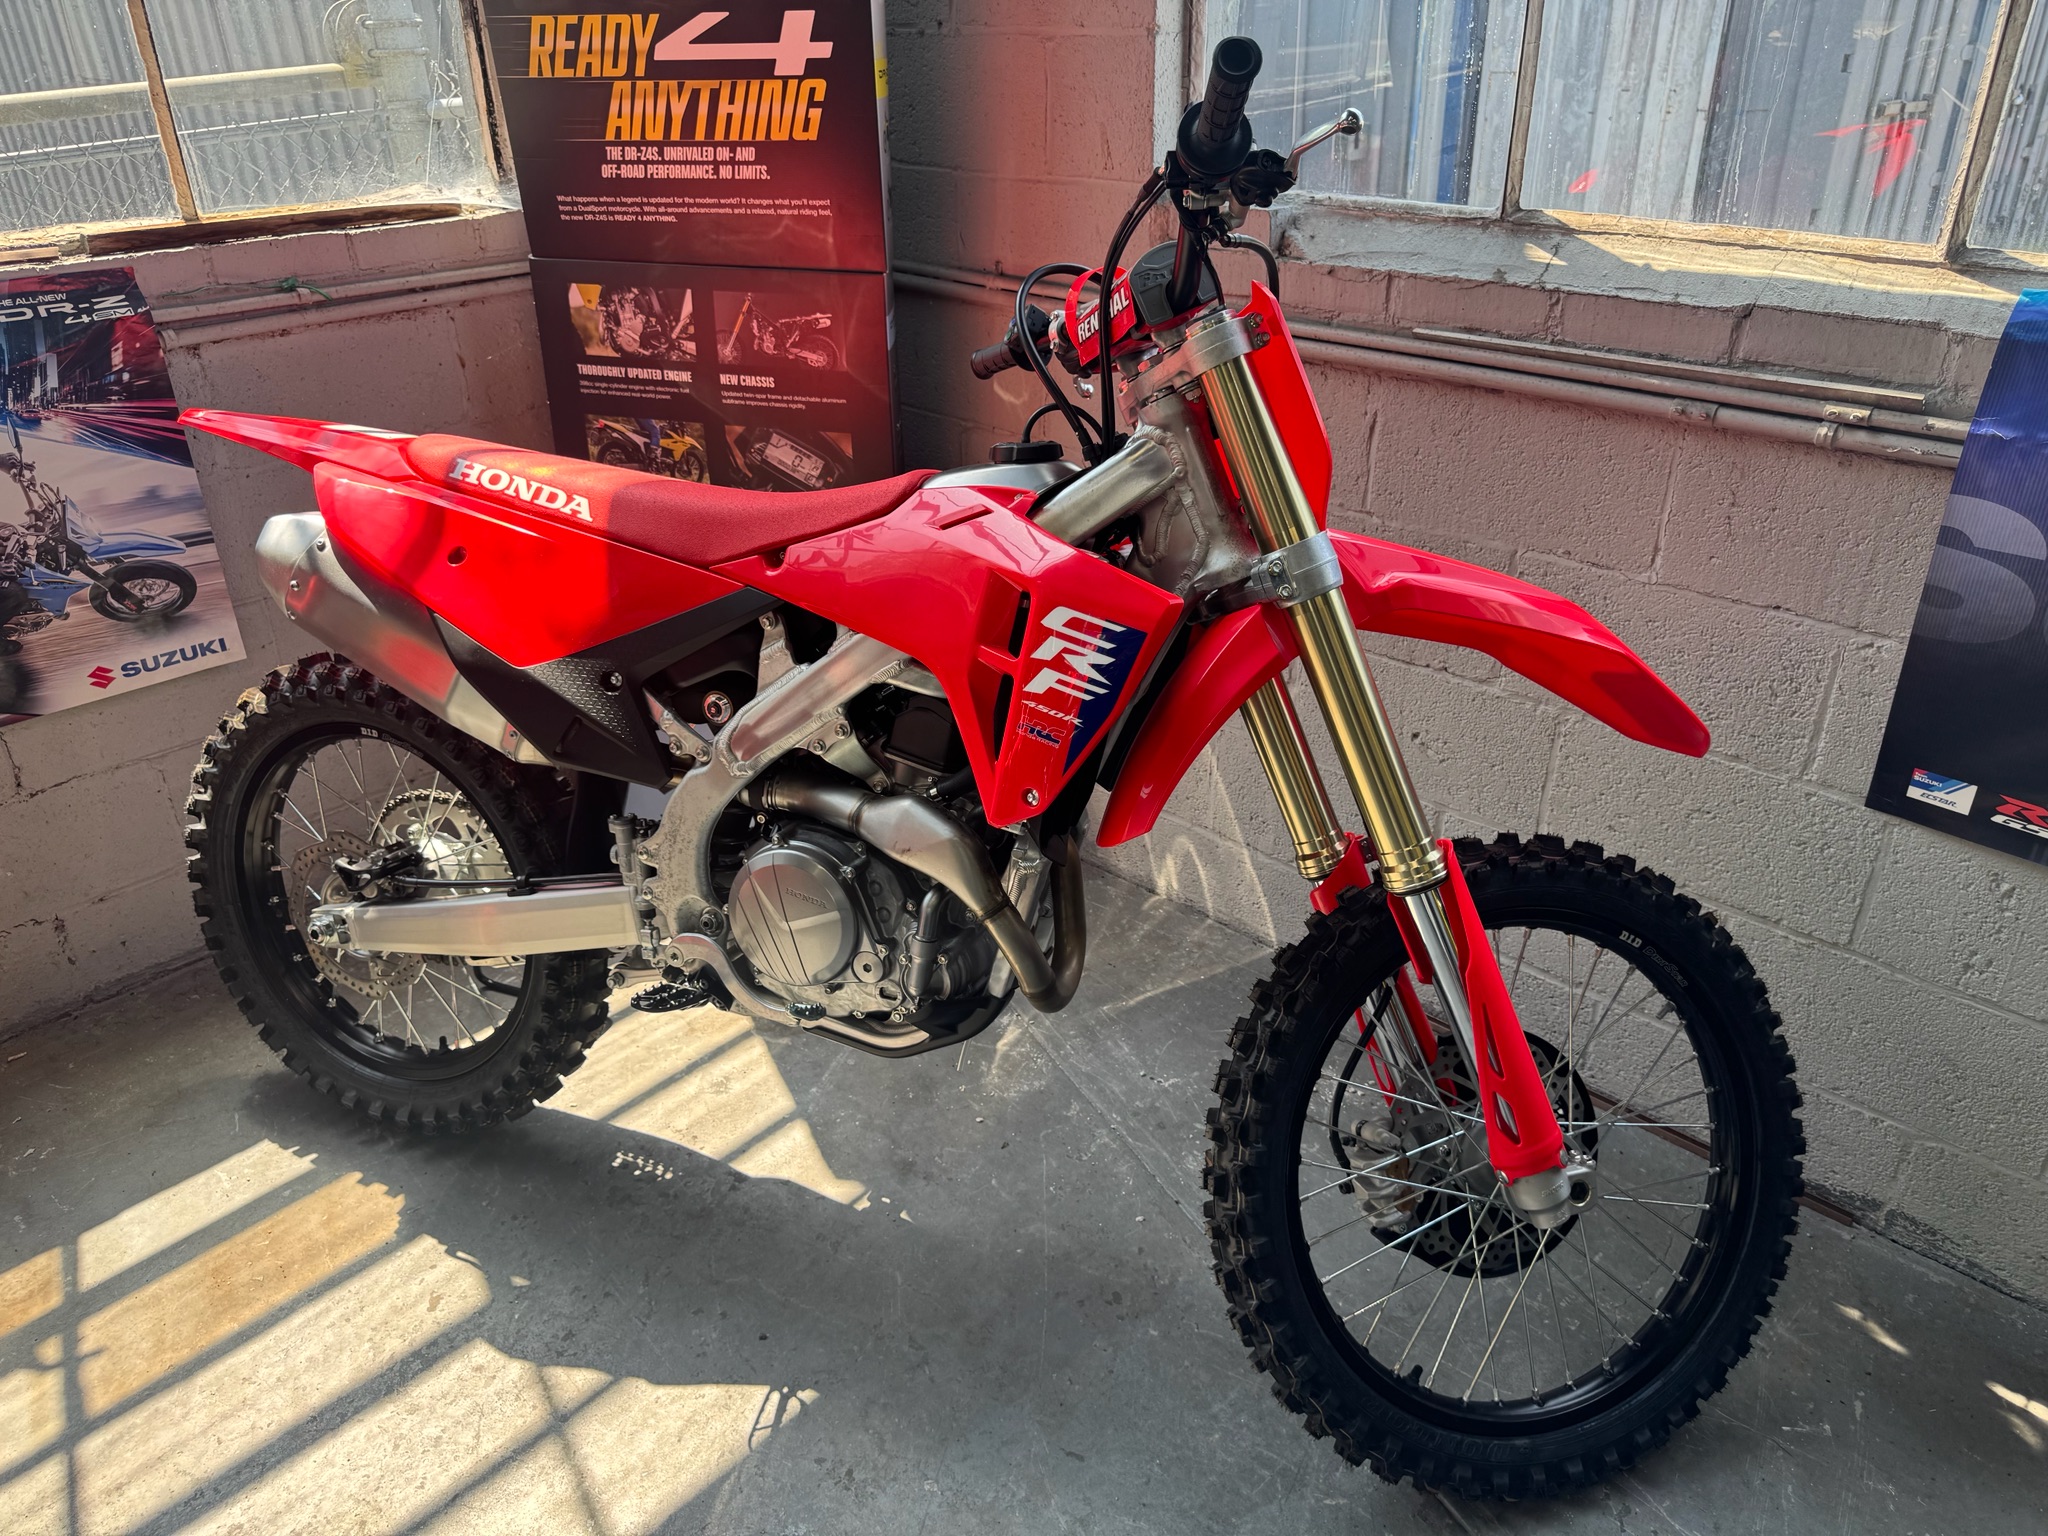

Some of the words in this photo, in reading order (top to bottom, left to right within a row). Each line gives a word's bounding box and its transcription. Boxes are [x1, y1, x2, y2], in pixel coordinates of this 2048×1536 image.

[528, 13, 660, 78] READY
[653, 10, 833, 76] 4
[605, 79, 827, 141] ANYTHING
[605, 146, 623, 161] THE
[624, 147, 662, 161] DR-Z4S.
[663, 147, 714, 162] UNRIVALED
[716, 147, 734, 162] ON-
[735, 147, 756, 162] AND
[601, 164, 645, 179] OFF-ROAD
[647, 164, 717, 180] PERFORMANCE.
[719, 165, 732, 180] NO
[734, 165, 771, 180] LIMITS.
[573, 196, 598, 205] happens
[747, 198, 773, 206] changes
[578, 205, 607, 213] DualSport
[800, 208, 817, 216] riding
[15, 293, 67, 306] ALL-NEW
[1077, 287, 1130, 344] RENAL
[577, 364, 626, 378] THOROUGHLY
[627, 367, 662, 380] UPDATED
[663, 370, 692, 383] ENGINE
[719, 373, 739, 386] NEW
[740, 374, 775, 388] CHASSIS
[721, 390, 743, 398] Updated
[743, 392, 766, 400] twin-spar
[793, 395, 821, 403] detachable
[449, 458, 594, 522] HONDA
[120, 637, 228, 678] SUZUKI
[1022, 606, 1127, 701] CRF
[1021, 699, 1084, 728] 450R
[1913, 775, 1943, 788] SUZUKI
[1920, 791, 1957, 807] ECSTAR
[785, 887, 828, 909] HONDA
